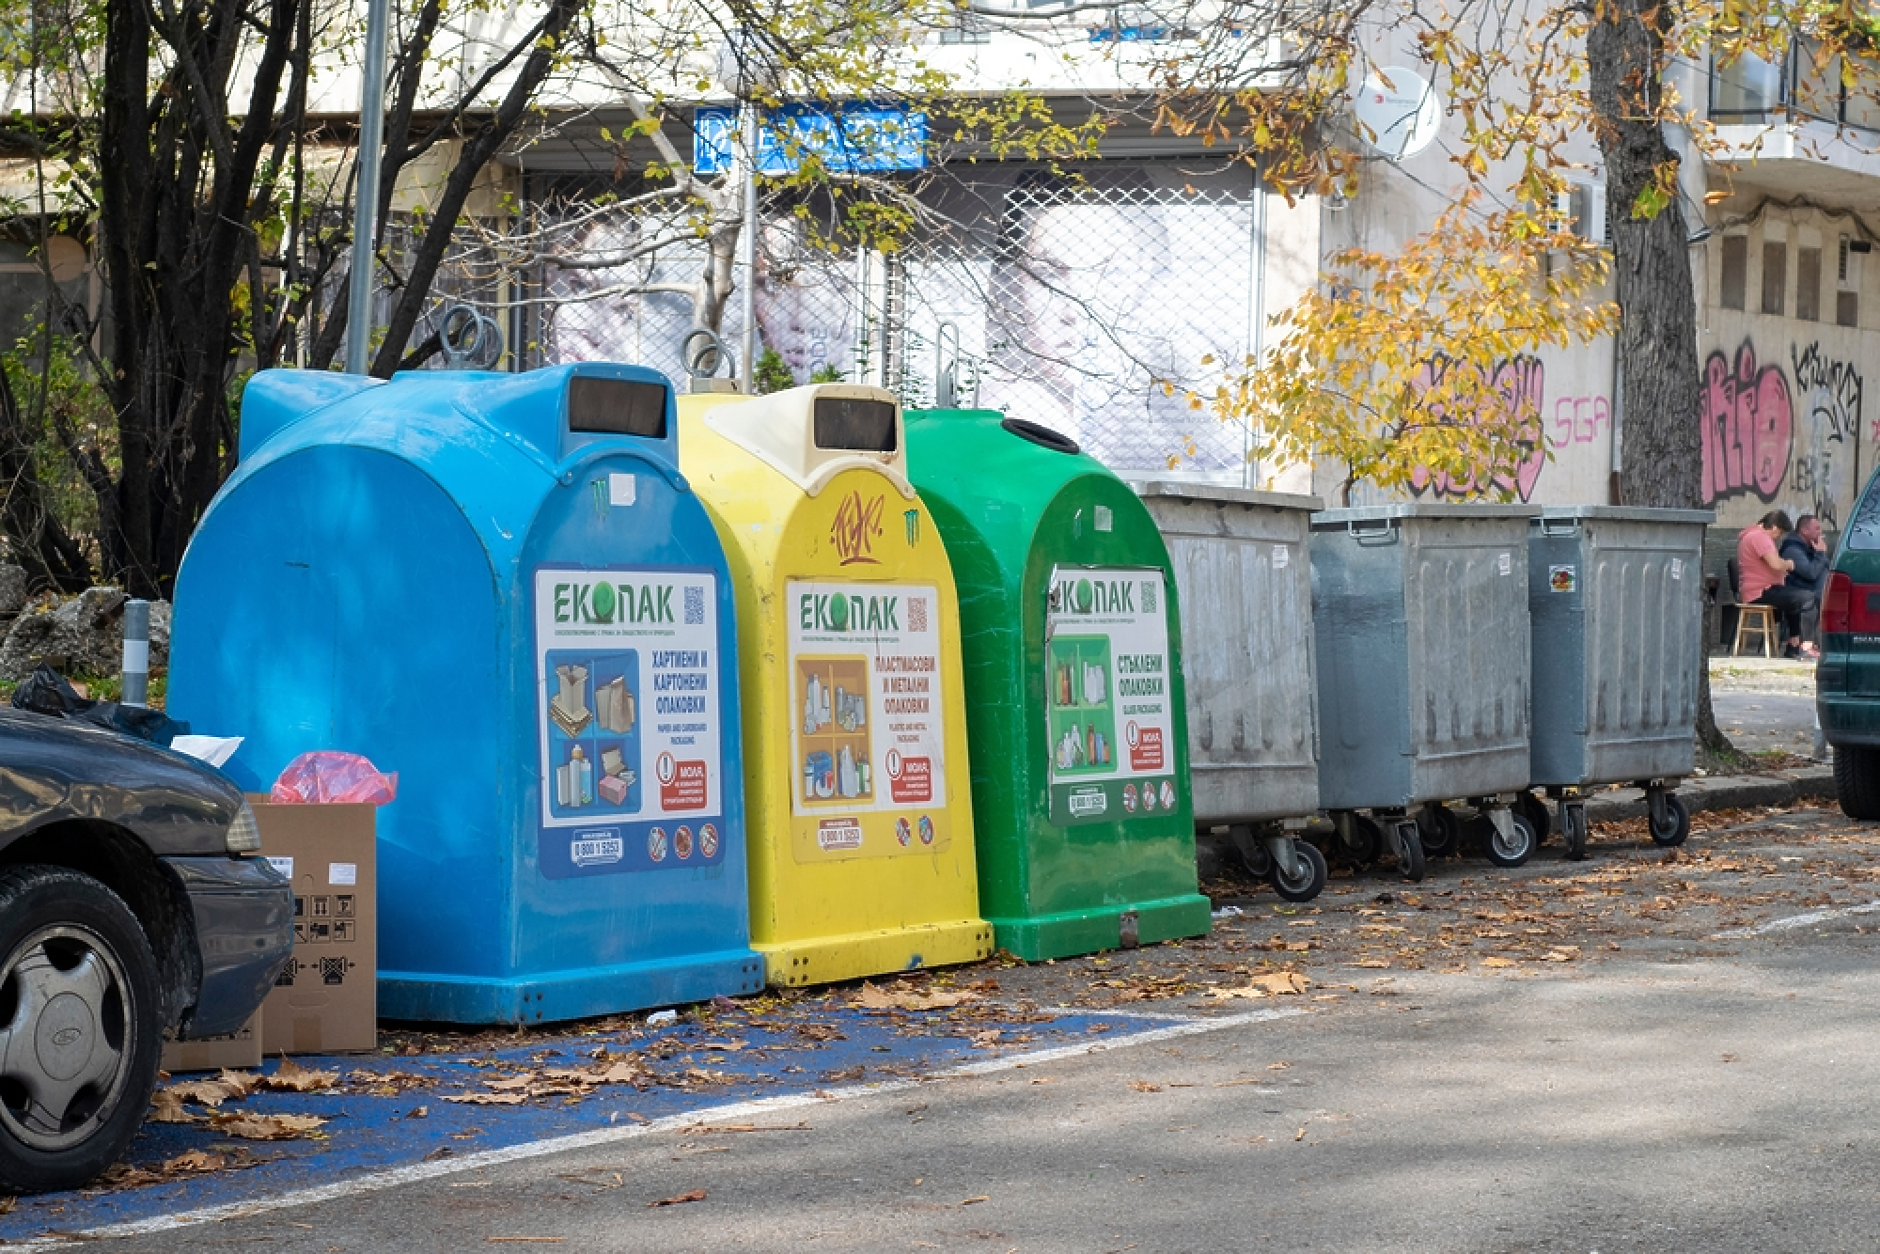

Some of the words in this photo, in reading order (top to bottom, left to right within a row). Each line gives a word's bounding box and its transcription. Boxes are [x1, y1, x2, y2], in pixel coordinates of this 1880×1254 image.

[1554, 395, 1611, 448] SGA
[554, 581, 675, 625] ЕКОПАК
[800, 591, 899, 632] ЕКОПАК
[652, 650, 699, 668] ХАРТИЕНИ
[1117, 653, 1163, 674] СТЪКЛЕНИ
[653, 673, 708, 691] КАРТОНЕНИ
[1119, 677, 1165, 696] ОПАКОВКИ
[655, 695, 706, 713] ОПАКОВКИ
[884, 697, 930, 714] ОПАКОВКИ
